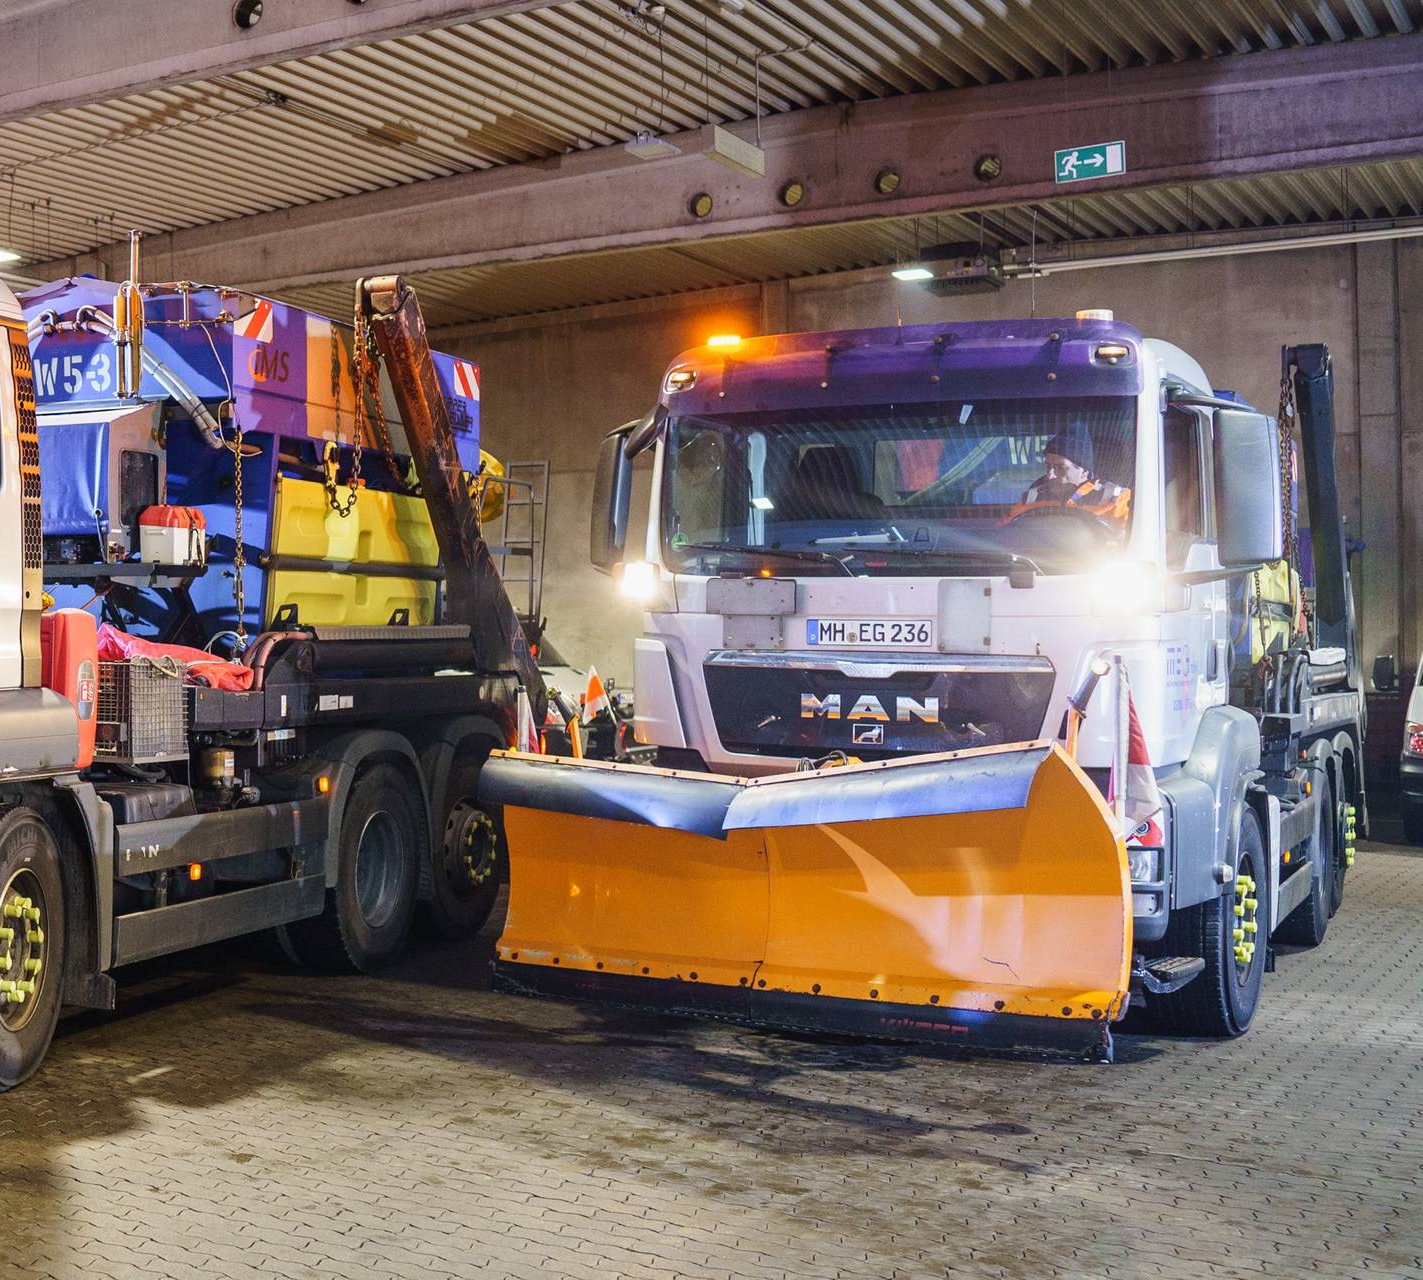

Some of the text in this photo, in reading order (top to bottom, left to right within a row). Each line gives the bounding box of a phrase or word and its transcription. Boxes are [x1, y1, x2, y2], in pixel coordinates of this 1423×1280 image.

[819, 622, 845, 642] MH
[859, 623, 885, 642] EG
[890, 623, 929, 643] 236
[801, 693, 939, 723] MAN
